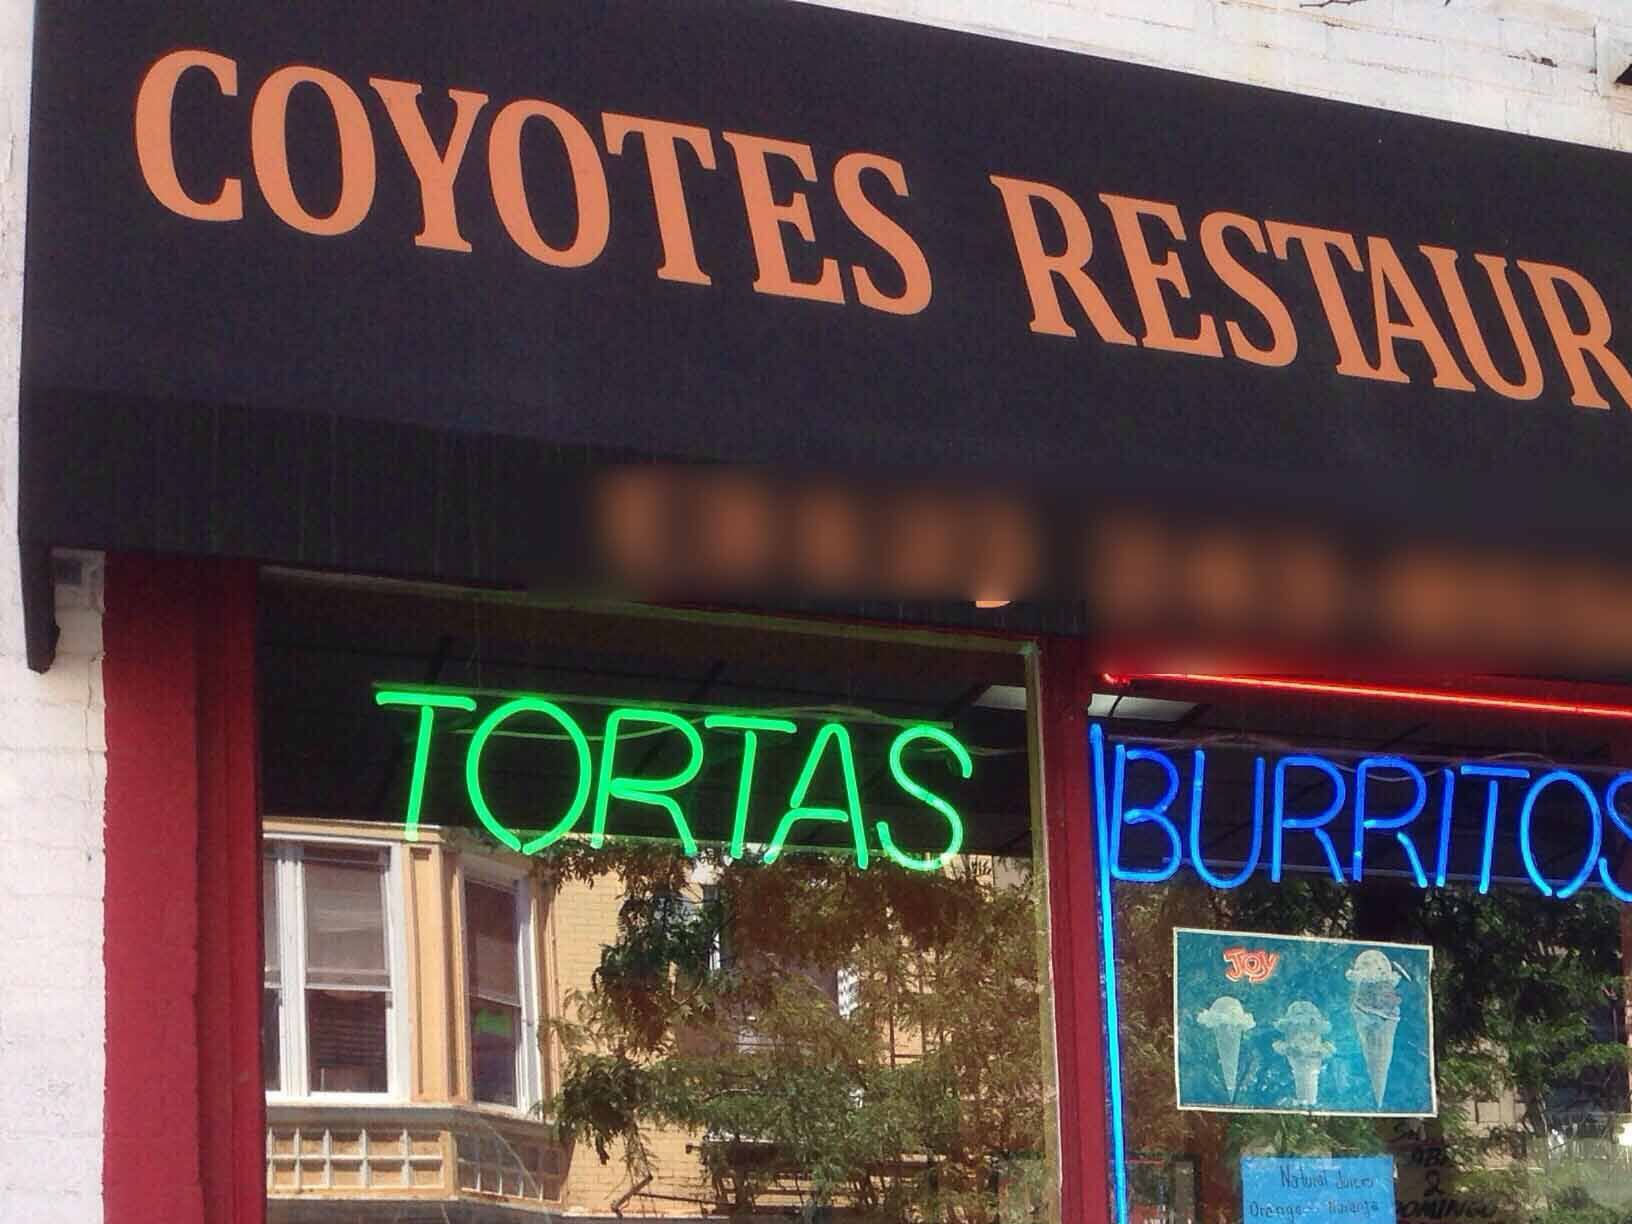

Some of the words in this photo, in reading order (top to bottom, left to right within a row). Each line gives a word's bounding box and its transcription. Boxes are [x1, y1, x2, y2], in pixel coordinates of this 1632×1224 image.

[135, 49, 934, 316] COYOTES
[376, 690, 973, 870] TORTAS
[1223, 946, 1279, 983] JOY
[1280, 1165, 1328, 1189] Natural
